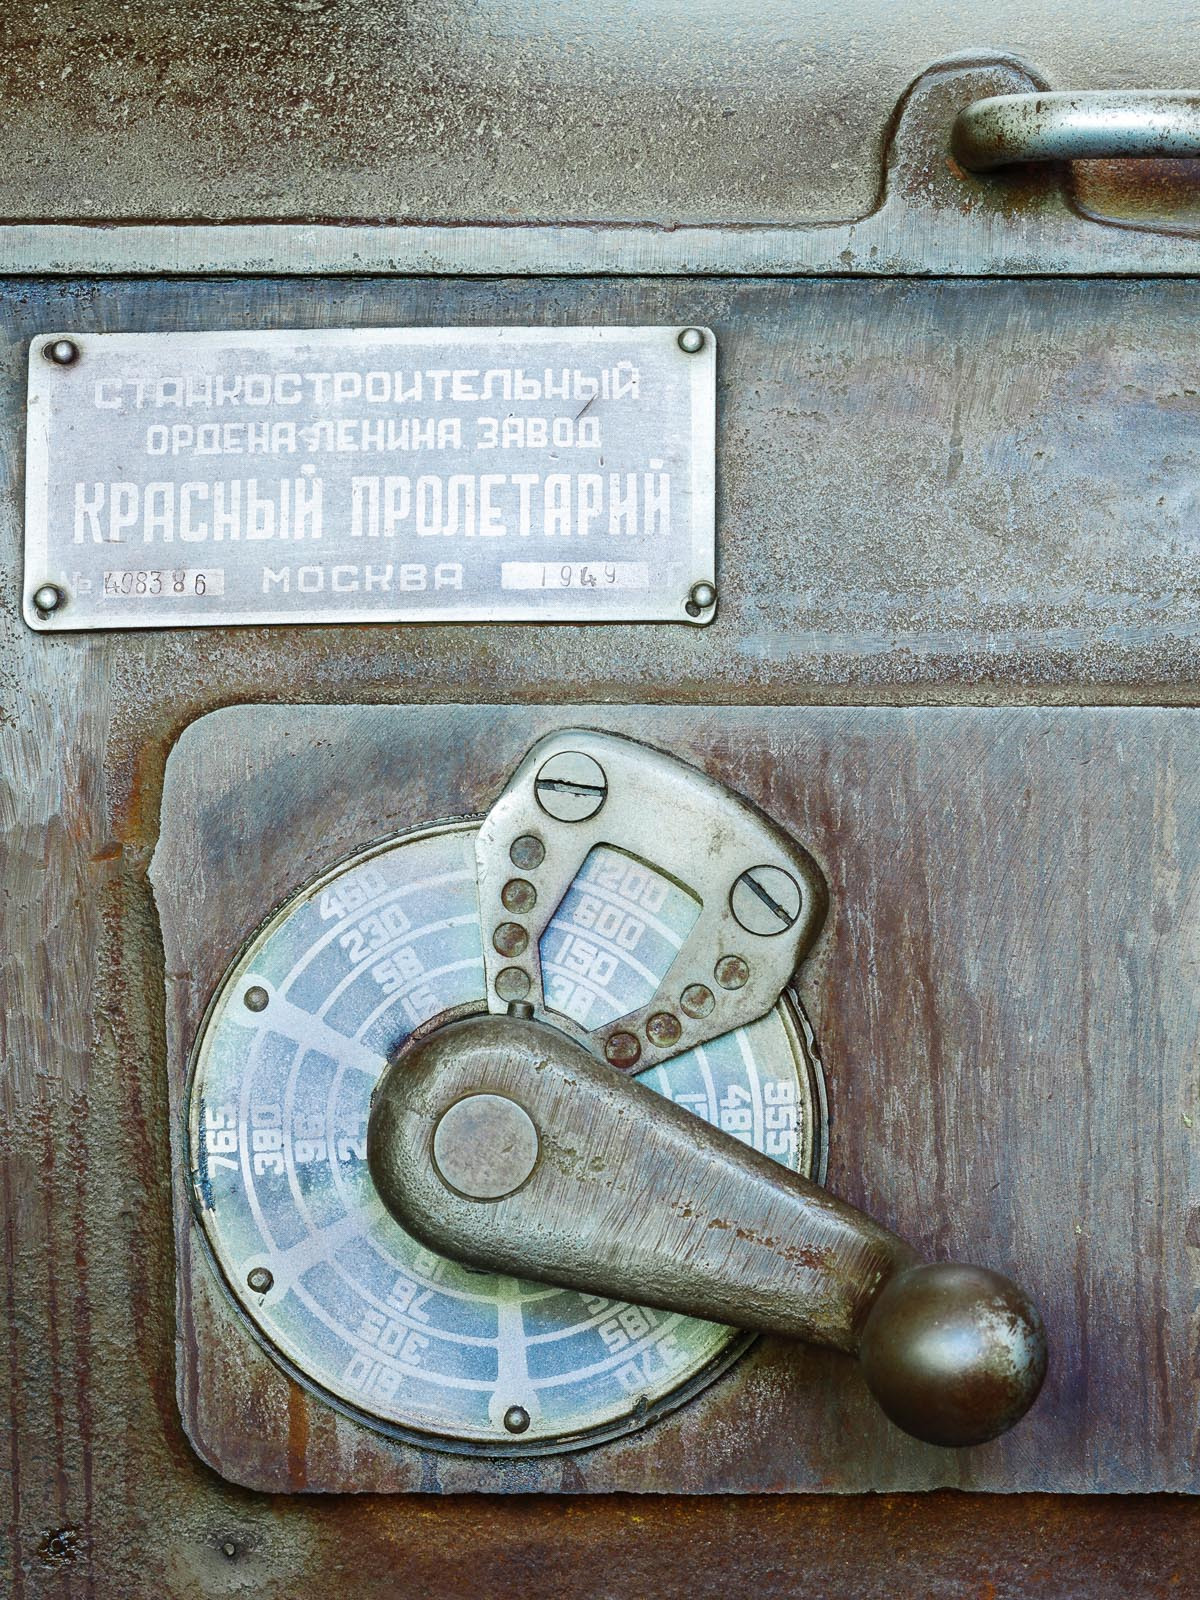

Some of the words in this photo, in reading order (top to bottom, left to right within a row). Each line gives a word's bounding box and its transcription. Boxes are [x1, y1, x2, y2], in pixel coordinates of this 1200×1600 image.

[94, 360, 640, 410] СТАНКОСТРОИТЕЛЬНЫЙ
[146, 420, 298, 455] ОРДЕНА
[306, 417, 462, 452] ЛЕНИНА
[477, 416, 602, 449] ЗАВОД
[73, 464, 322, 544] КРАСНЫЙ
[350, 458, 671, 537] ПРОЛЕТАРИЙ
[262, 562, 463, 593] МОСКВА
[320, 869, 387, 921] 460
[339, 903, 412, 964] 230
[572, 894, 646, 951] 600
[371, 945, 425, 995] 58
[554, 934, 620, 986] 150
[205, 1103, 239, 1179] 765
[252, 1103, 285, 1176] 380
[763, 1080, 798, 1155] 955
